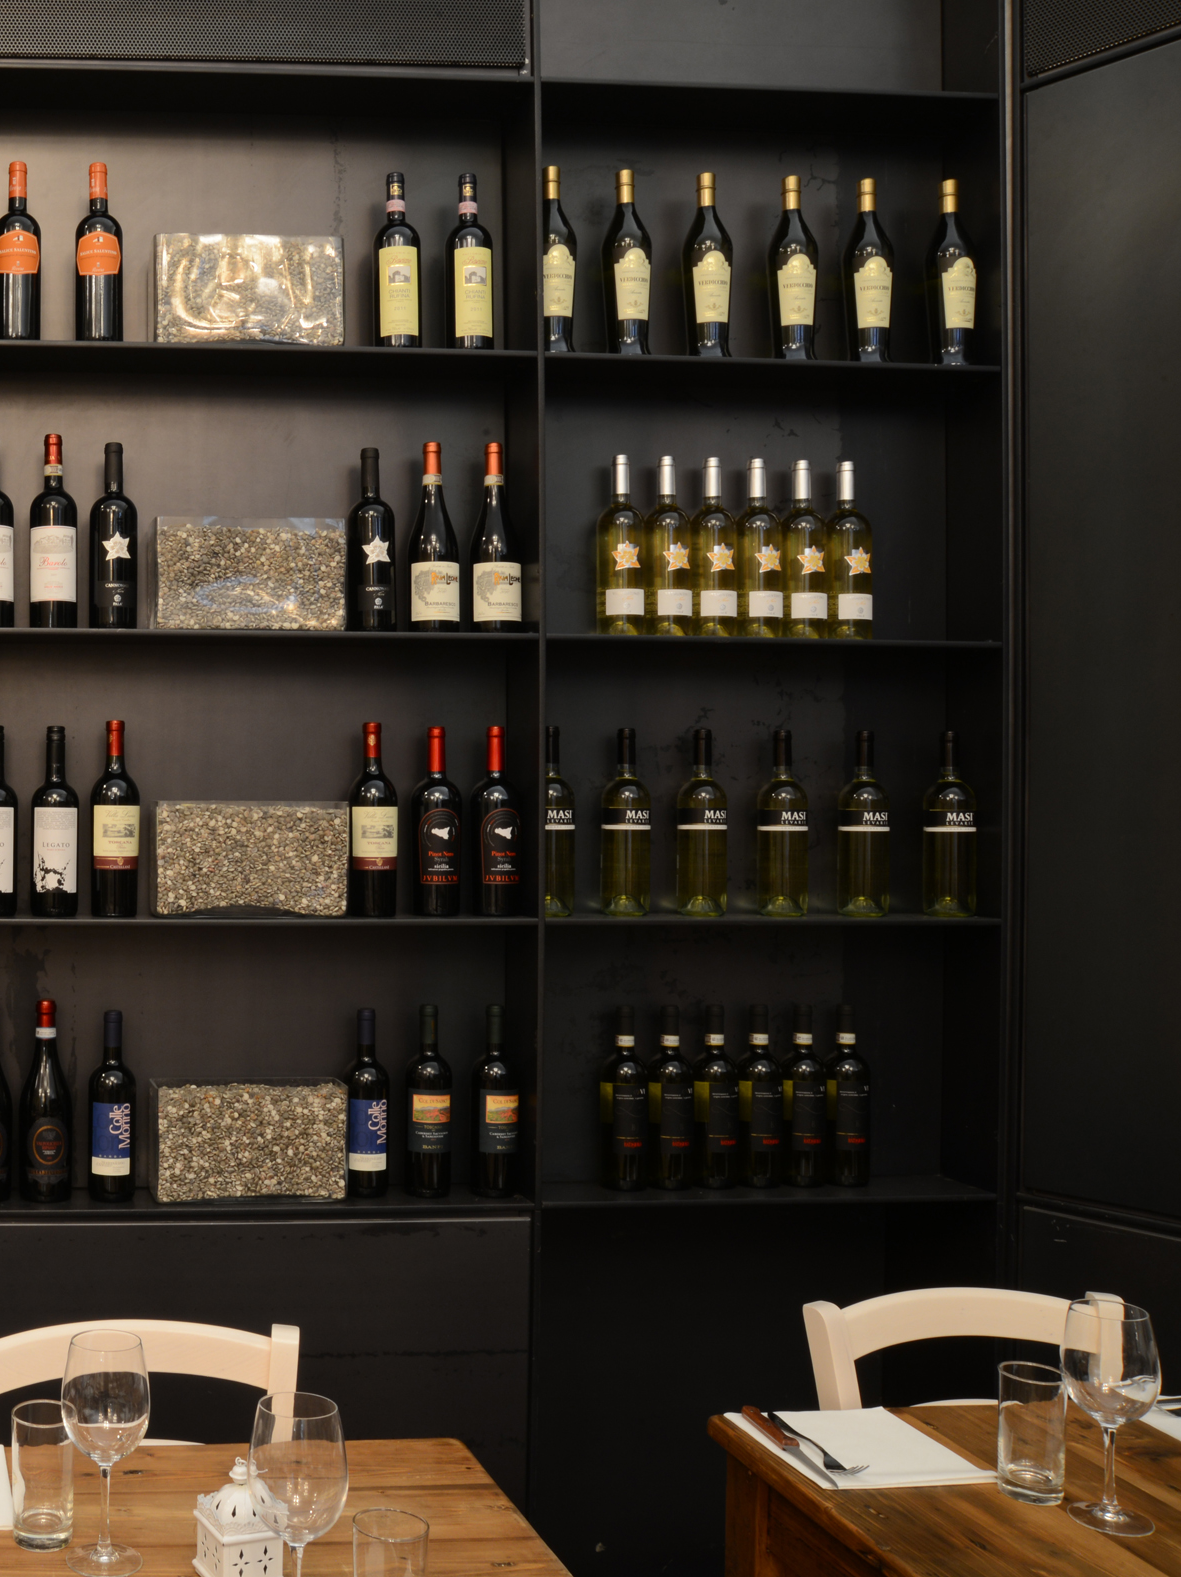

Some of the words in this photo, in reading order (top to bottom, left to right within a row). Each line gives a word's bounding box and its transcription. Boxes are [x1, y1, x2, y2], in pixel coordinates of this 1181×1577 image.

[38, 556, 68, 567] Barolo
[547, 810, 572, 819] MASI
[625, 810, 650, 819] MASI
[704, 810, 727, 819] MASI
[781, 811, 806, 820] MASI
[862, 811, 888, 821] MASI
[946, 812, 973, 822] MASI
[109, 1105, 123, 1135] Colle
[367, 1101, 381, 1131] Colle
